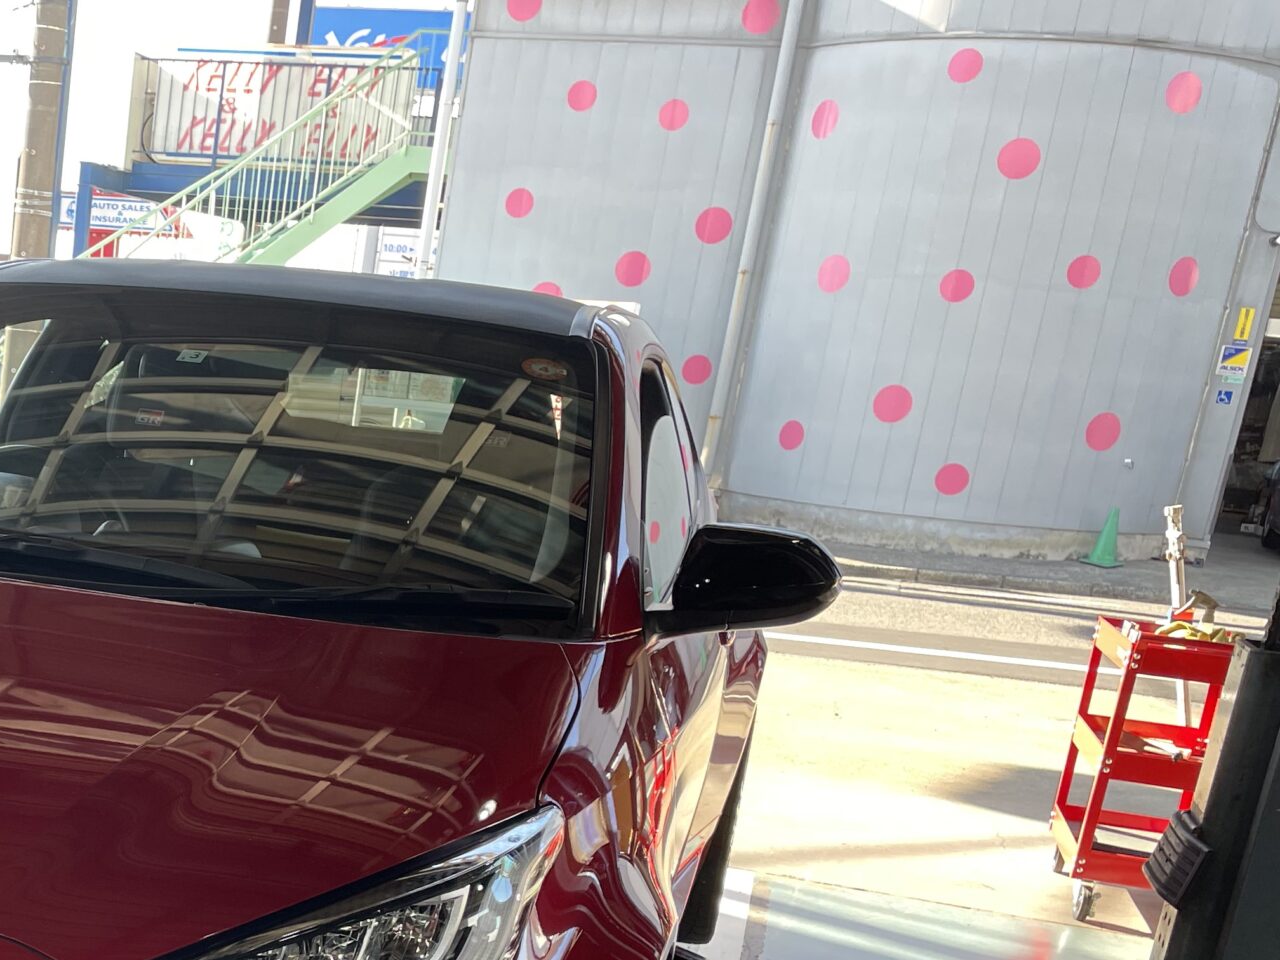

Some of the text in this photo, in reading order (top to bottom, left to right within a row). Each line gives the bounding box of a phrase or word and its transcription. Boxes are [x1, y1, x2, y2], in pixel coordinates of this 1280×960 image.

[177, 116, 277, 153] KELLY
[91, 202, 151, 212] AUTO SALES
[92, 215, 149, 225] INSURANE
